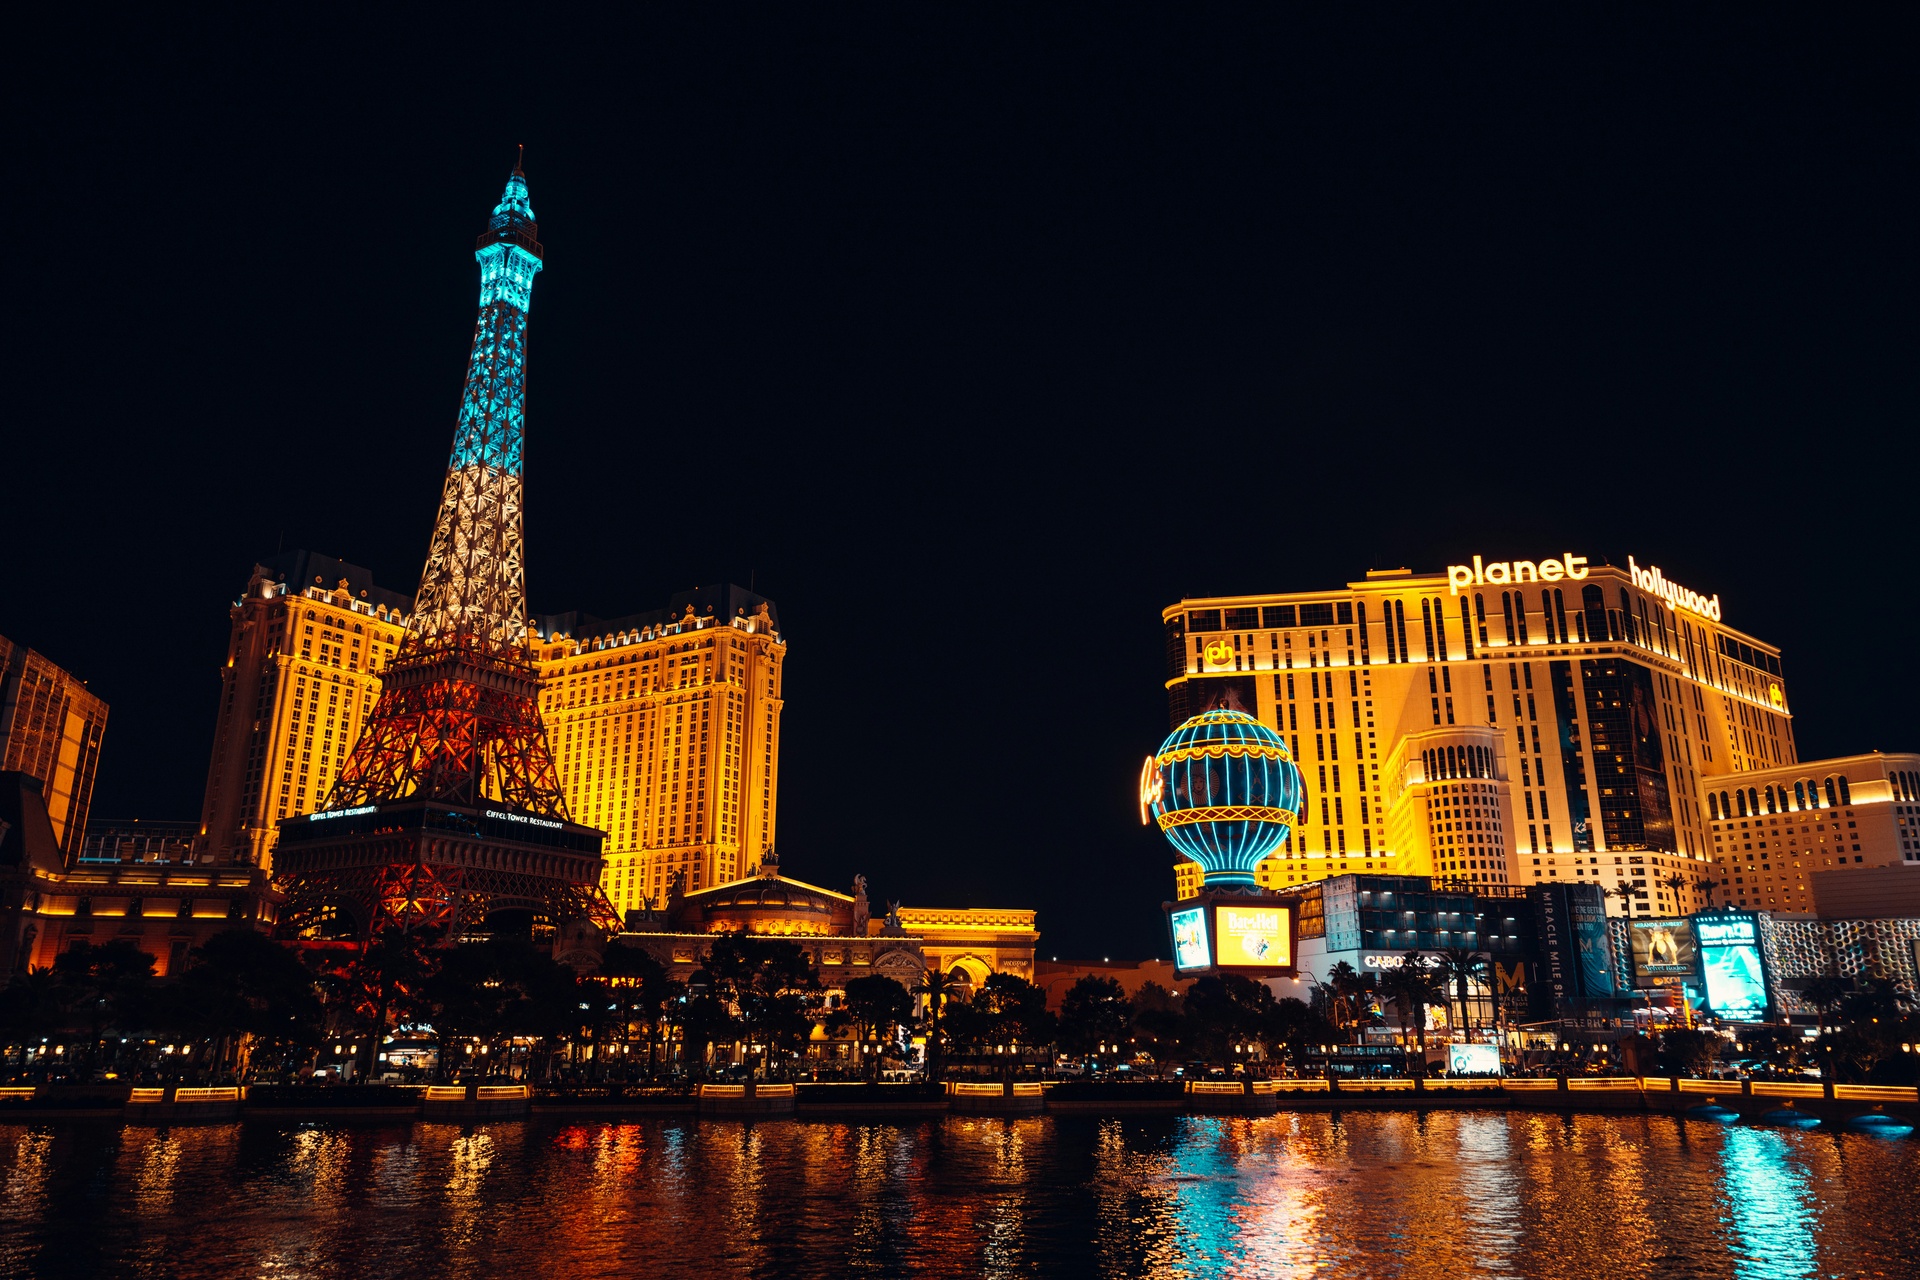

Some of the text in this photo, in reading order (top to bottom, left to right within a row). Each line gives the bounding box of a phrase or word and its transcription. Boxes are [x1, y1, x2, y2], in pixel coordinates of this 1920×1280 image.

[1448, 552, 1589, 596] planet
[1628, 555, 1722, 622] hollywood
[1206, 640, 1233, 664] ph
[310, 806, 375, 821] EIFFEL TOWER RESTAURANT
[486, 809, 563, 829] EIFFEL TOWER RESTAURANT
[1542, 892, 1558, 946] MIRACLE
[1364, 955, 1404, 969] CABO
[1549, 951, 1562, 979] MILE
[1494, 961, 1526, 994] M
[1573, 1018, 1622, 1027] SEPHR
